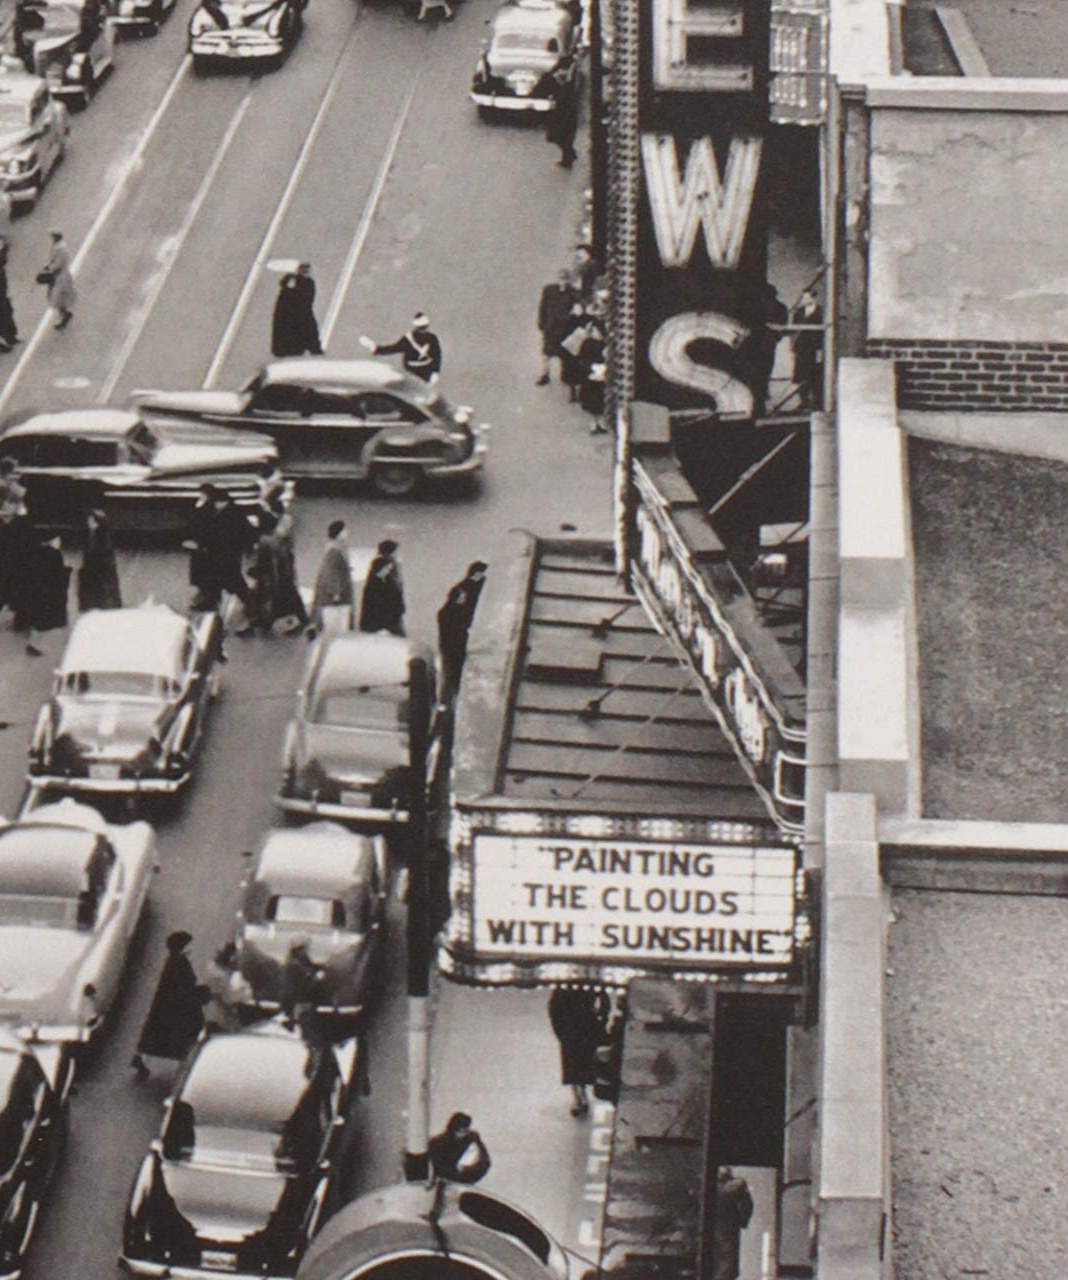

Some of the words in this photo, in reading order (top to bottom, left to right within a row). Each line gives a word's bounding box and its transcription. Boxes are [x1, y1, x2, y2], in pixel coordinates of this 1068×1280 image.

[538, 845, 715, 879] "PAINTING
[524, 883, 587, 910] THE
[601, 886, 739, 916] CLOUDS
[487, 919, 574, 947] WITH
